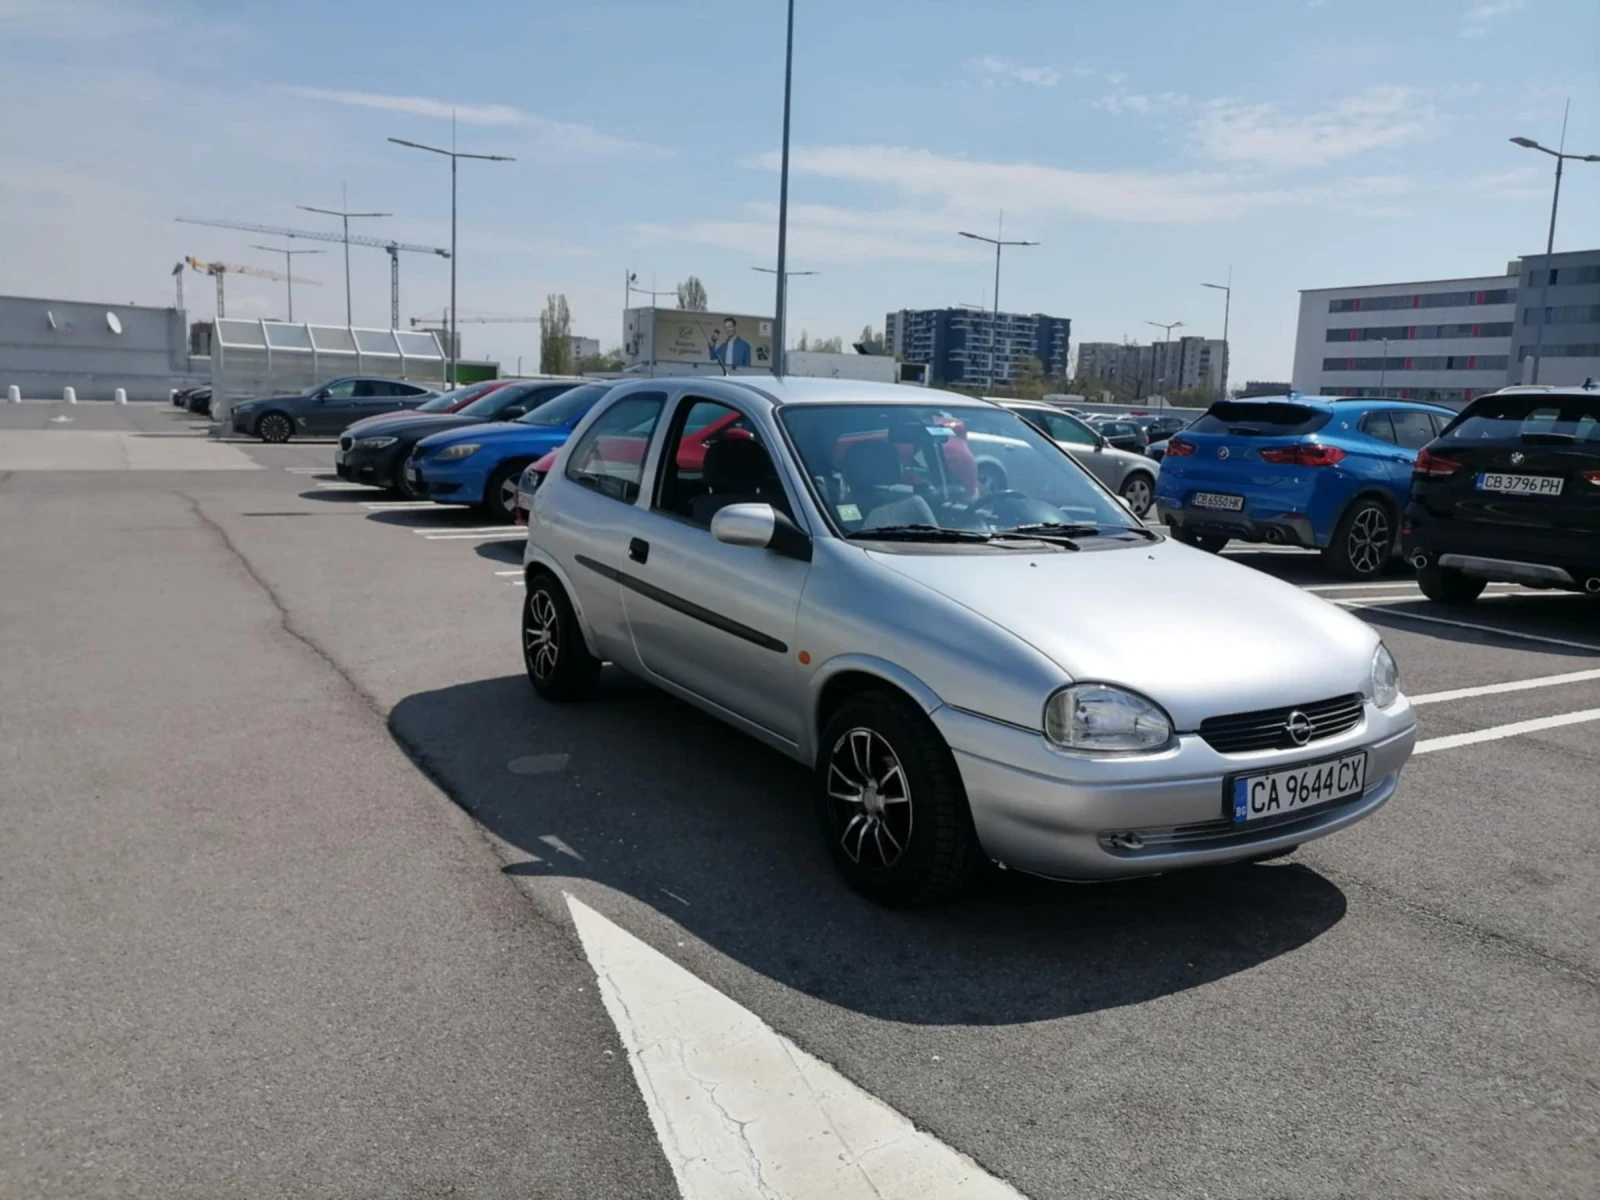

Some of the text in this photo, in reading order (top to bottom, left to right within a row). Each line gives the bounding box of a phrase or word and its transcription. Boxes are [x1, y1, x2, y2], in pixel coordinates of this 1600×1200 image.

[1485, 475, 1502, 489] CB
[1504, 477, 1538, 491] 3796
[1539, 479, 1560, 493] PH
[1251, 779, 1280, 813] CA
[1286, 767, 1334, 807] 9644
[1337, 759, 1361, 792] CX
